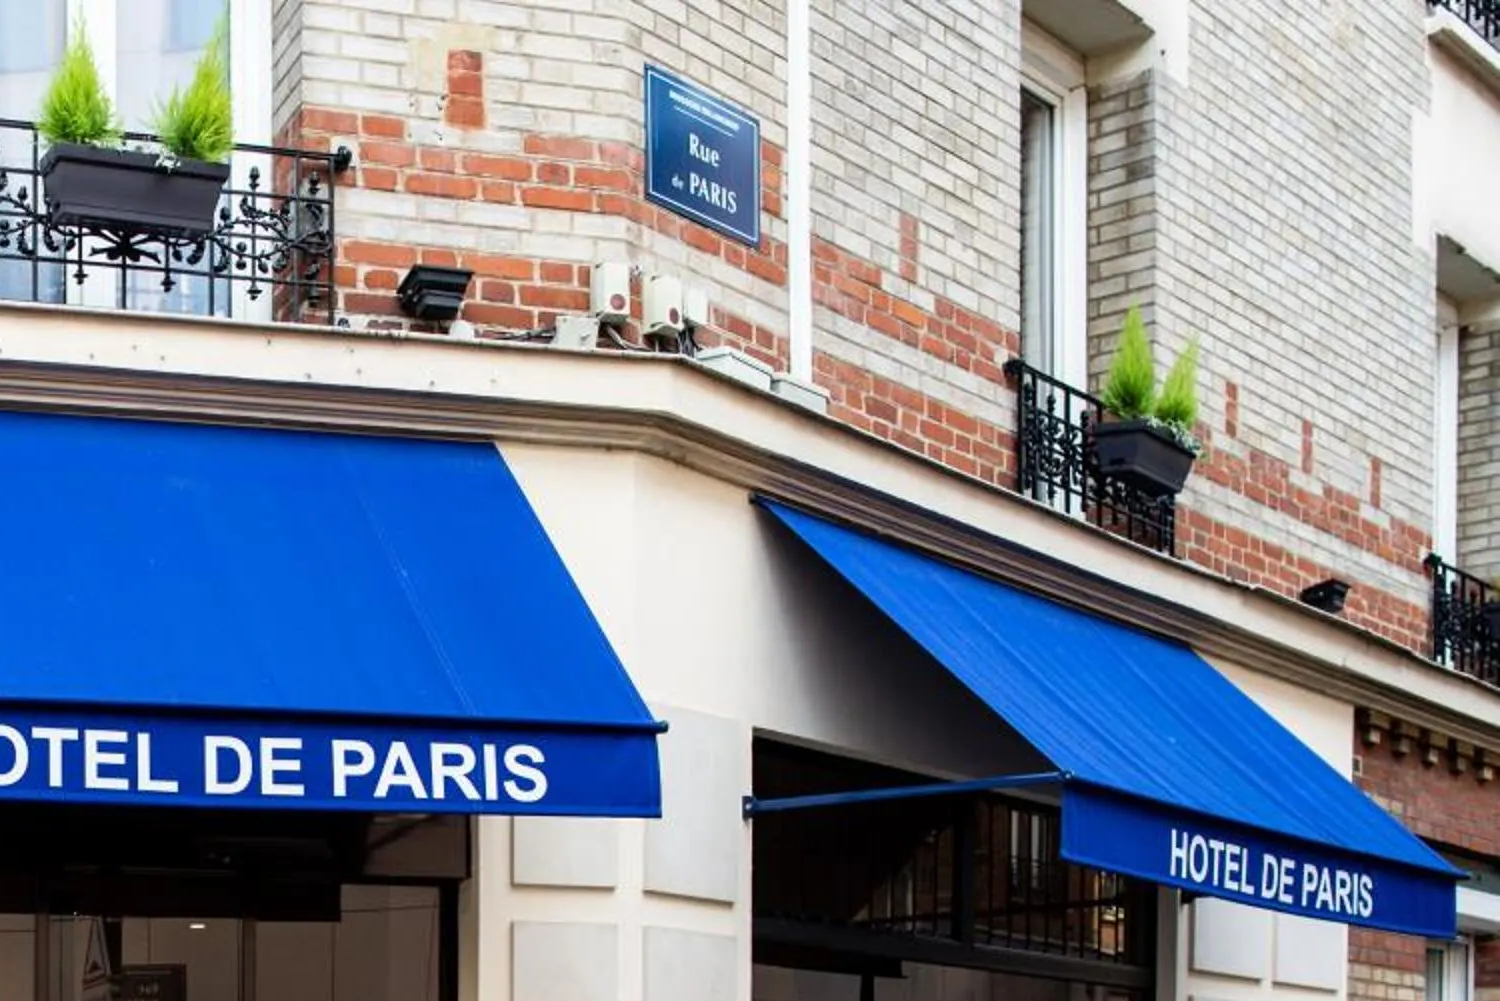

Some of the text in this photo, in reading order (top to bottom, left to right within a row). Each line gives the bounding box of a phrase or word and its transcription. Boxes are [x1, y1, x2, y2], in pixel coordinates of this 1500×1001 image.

[688, 132, 720, 168] Rue
[671, 172, 737, 214] de PARIS
[204, 735, 305, 796] DE
[331, 739, 548, 802] PARIS
[1170, 828, 1373, 918] HOTEL DE PARIS
